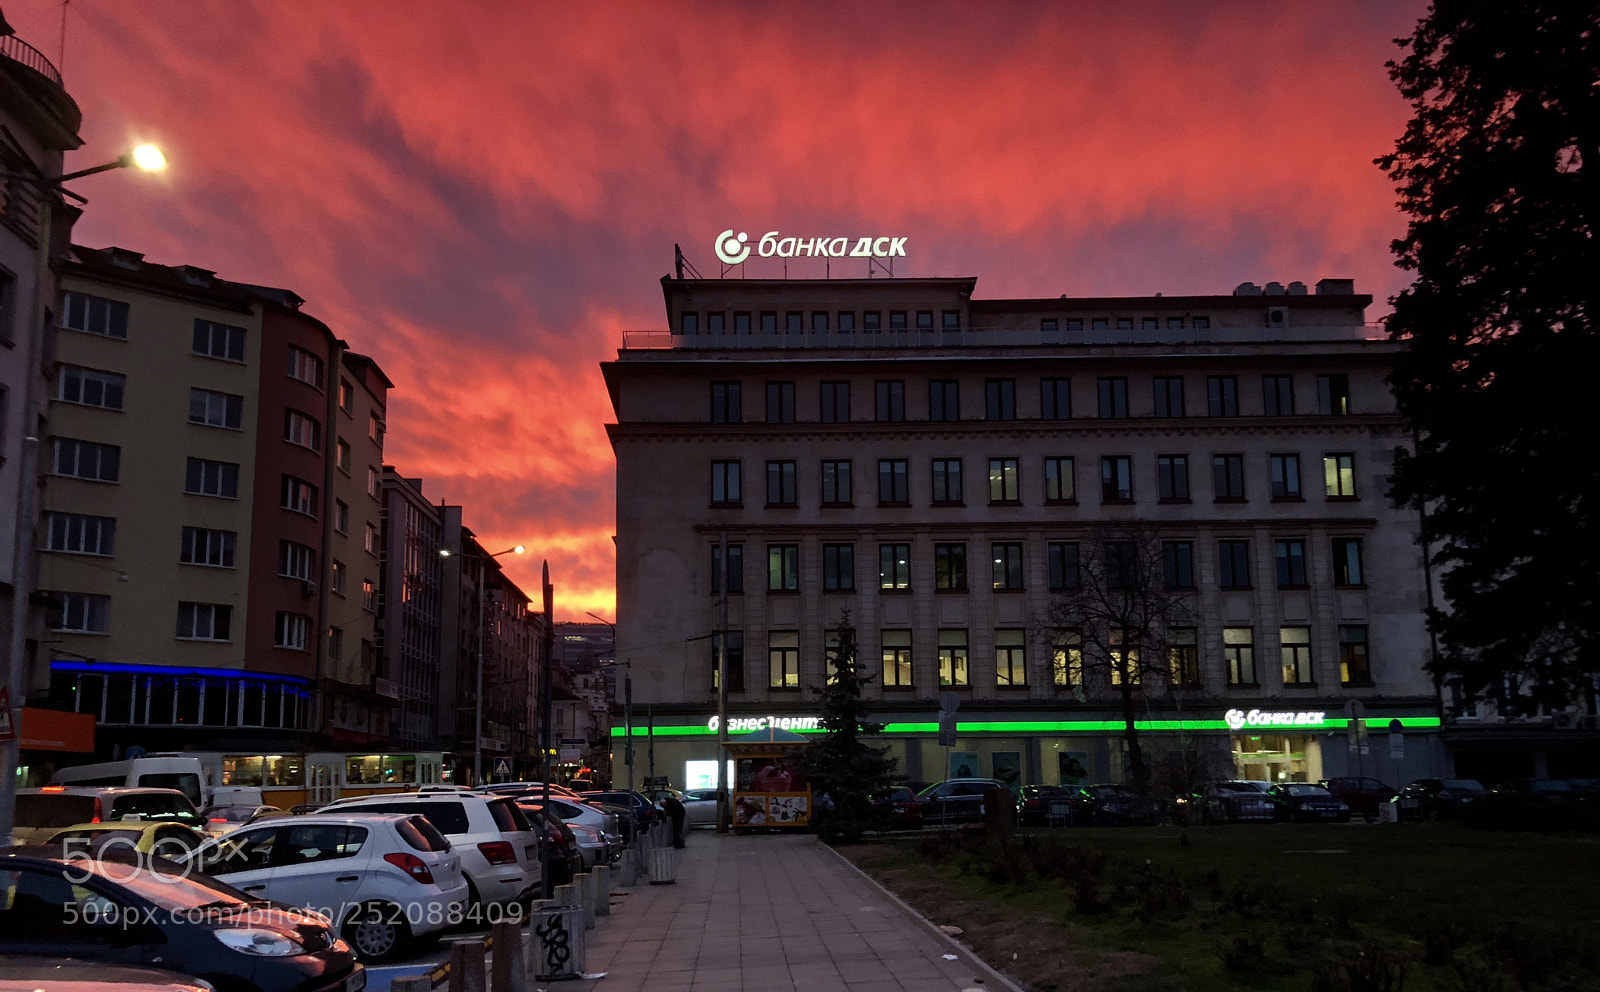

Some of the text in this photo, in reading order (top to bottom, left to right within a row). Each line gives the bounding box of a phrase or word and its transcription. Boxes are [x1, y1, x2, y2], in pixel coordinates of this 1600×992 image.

[758, 231, 848, 258] банка
[708, 716, 767, 731] бзнес
[1247, 709, 1294, 725] банка
